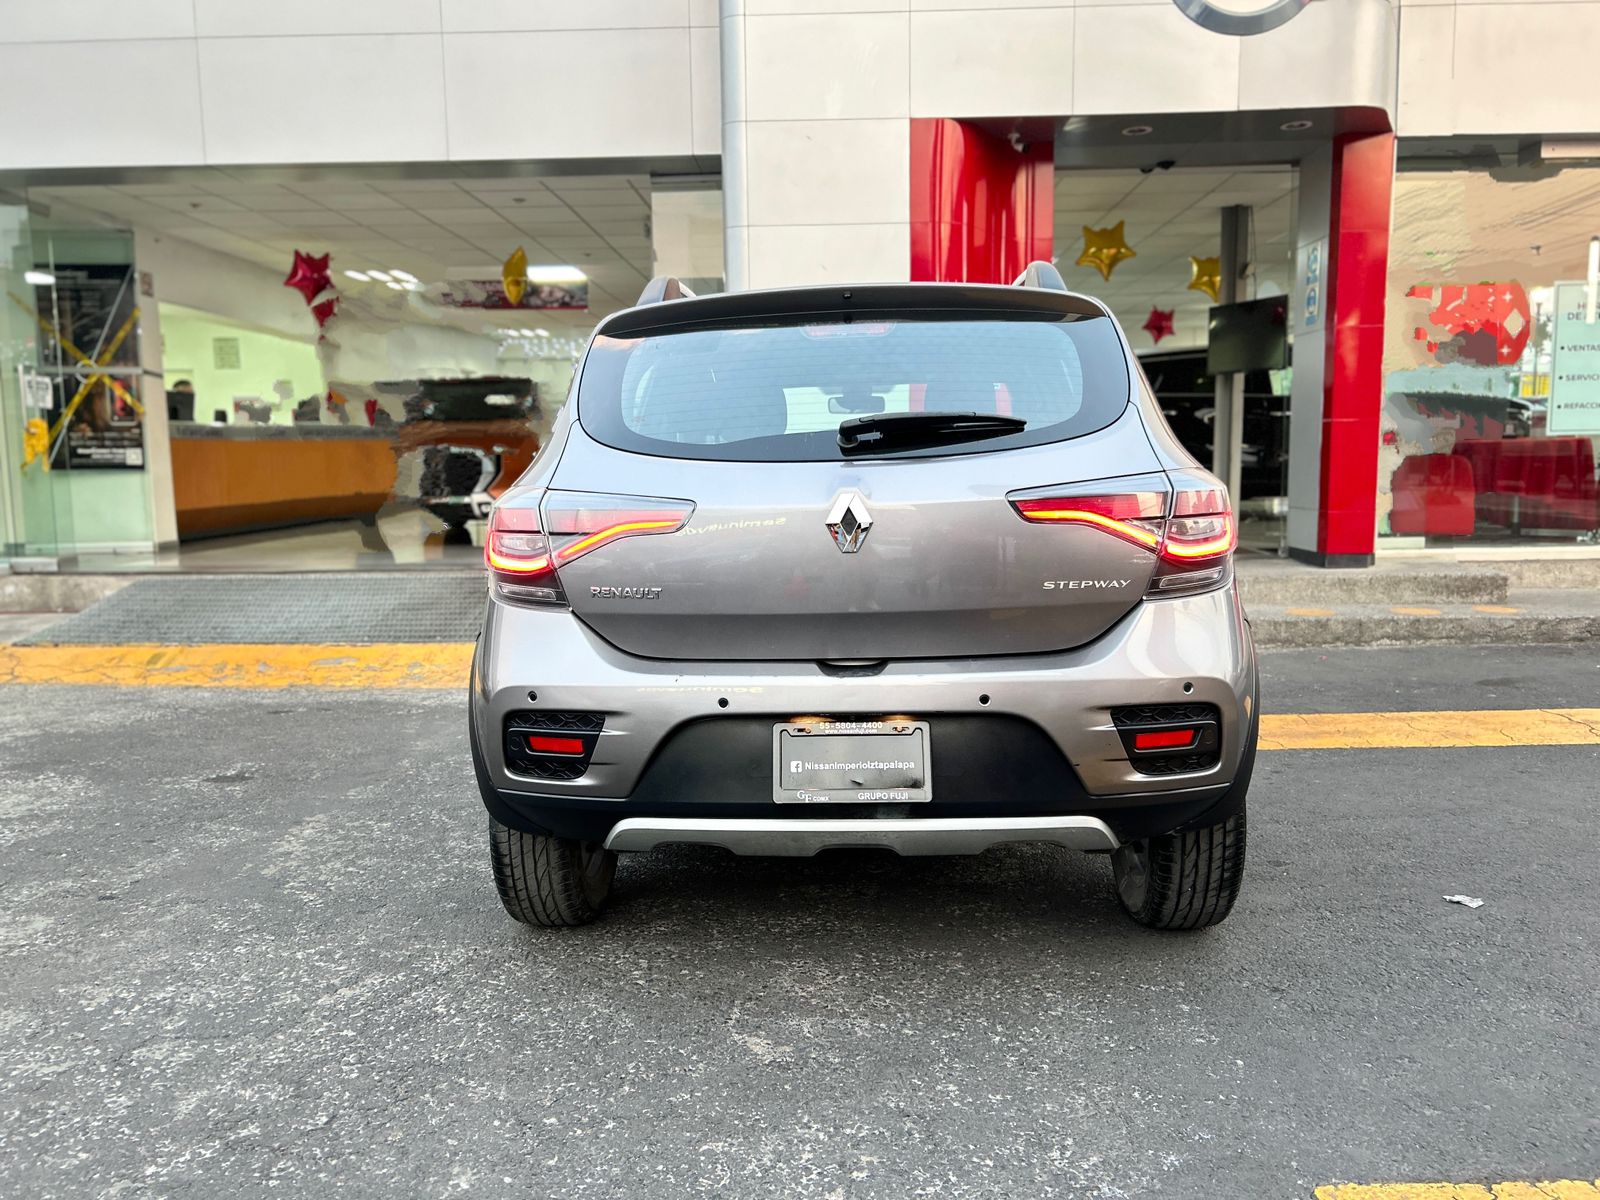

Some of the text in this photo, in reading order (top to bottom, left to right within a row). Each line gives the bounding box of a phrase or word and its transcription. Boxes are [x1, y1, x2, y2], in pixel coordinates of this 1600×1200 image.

[1042, 579, 1131, 589] STEPWAY
[590, 586, 662, 600] RENAULT
[857, 792, 909, 800] GRUPO FUJI
